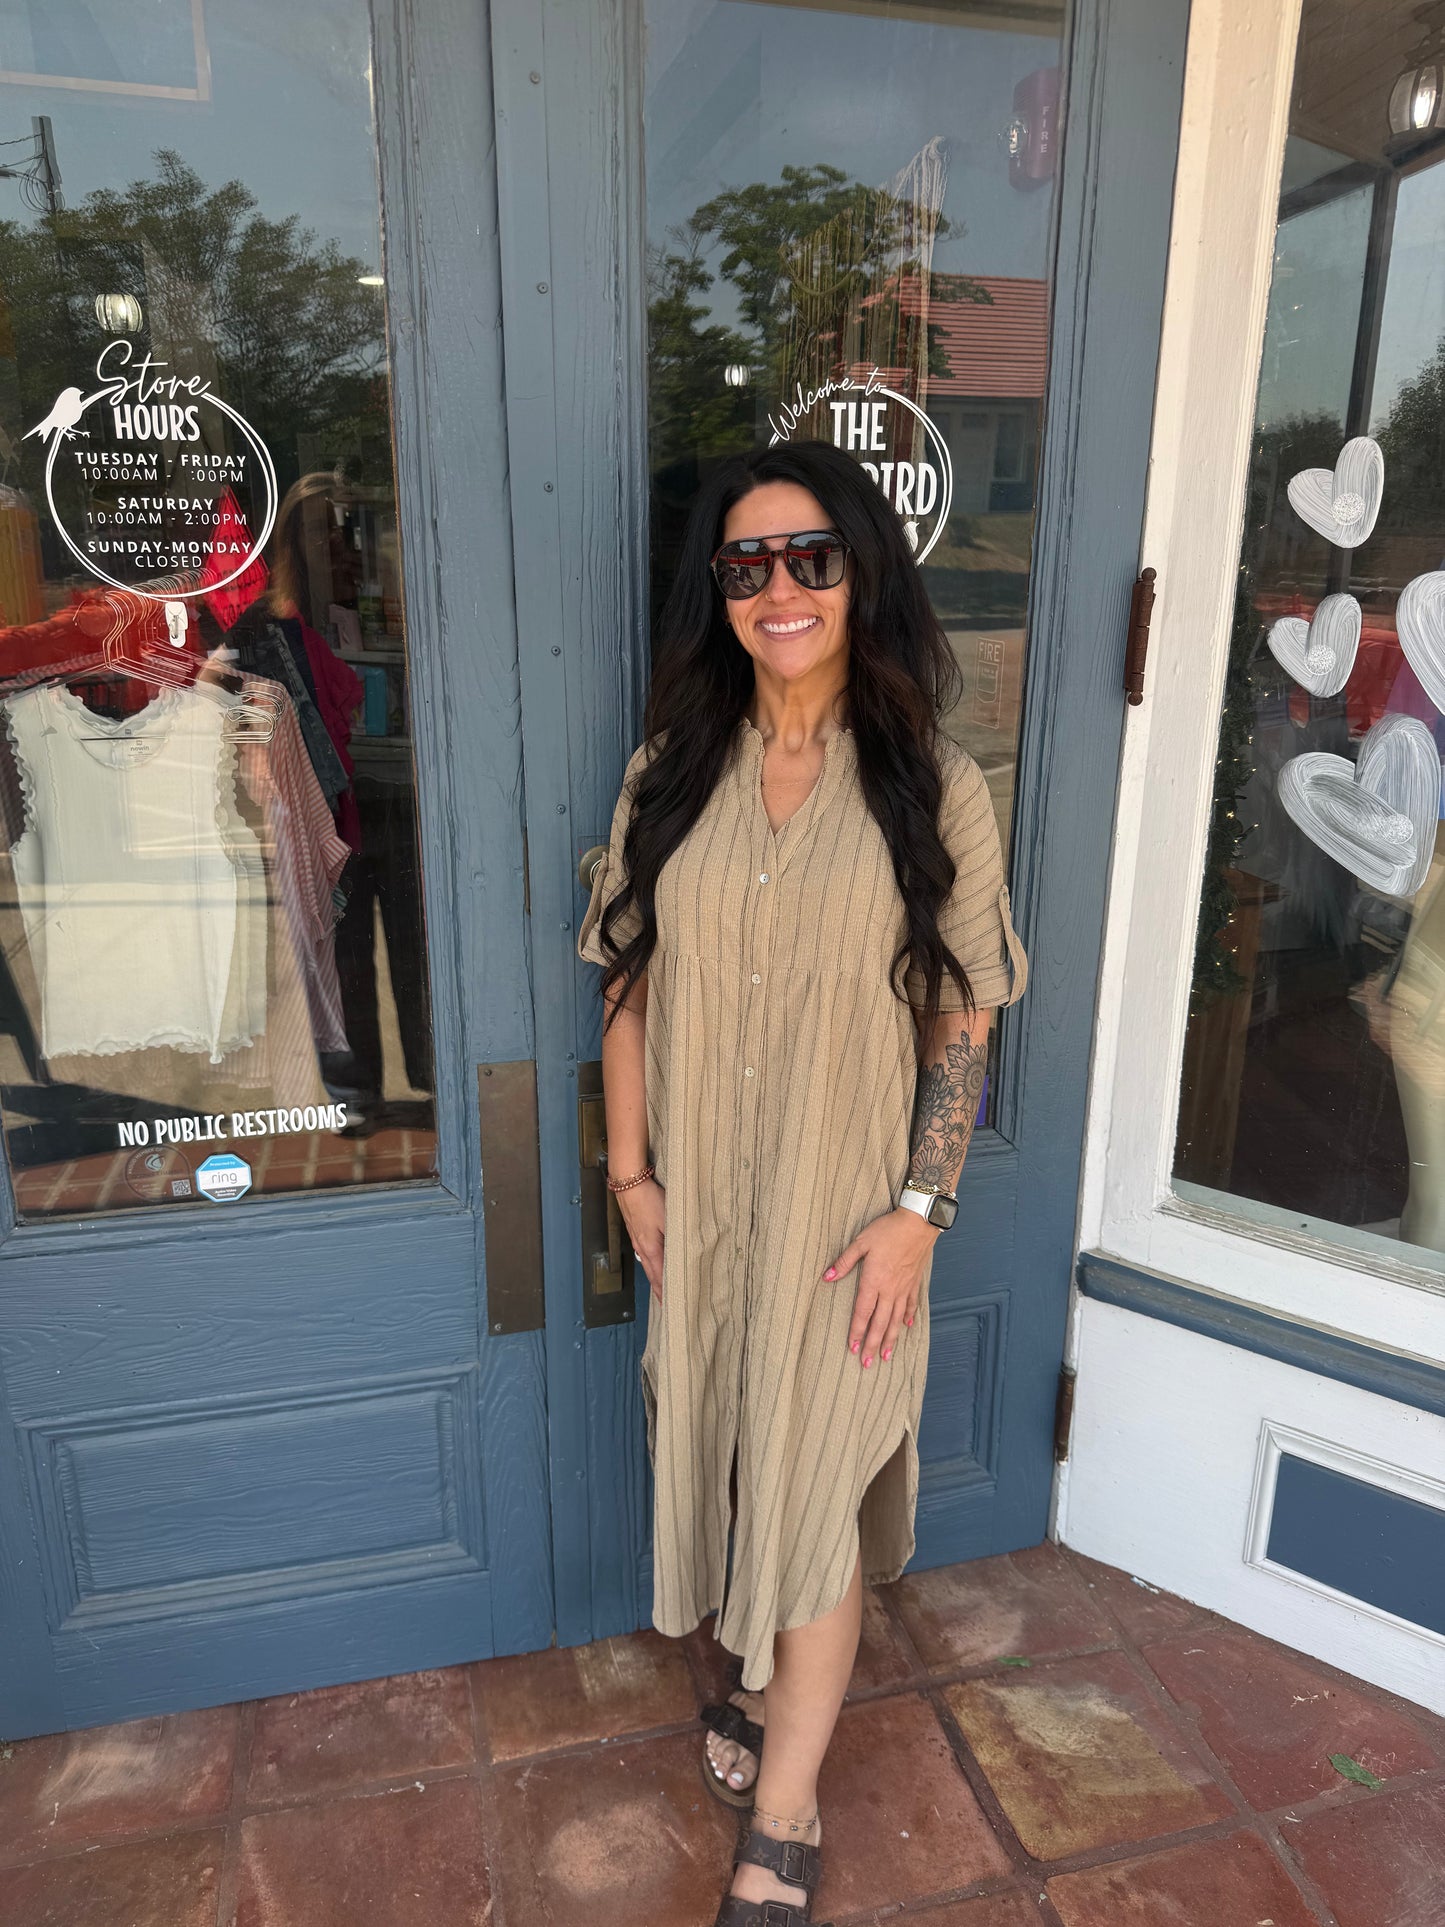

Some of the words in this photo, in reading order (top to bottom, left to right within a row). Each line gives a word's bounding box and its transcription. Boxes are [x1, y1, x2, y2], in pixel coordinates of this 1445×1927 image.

[1040, 105, 1050, 153] FIRE
[97, 340, 211, 405] Store
[768, 376, 855, 441] Welcome
[863, 366, 887, 396] to
[113, 404, 201, 442] HOURS
[829, 402, 887, 450] THE
[74, 452, 159, 466] TUESDAY
[180, 454, 247, 468] FRIDAY
[81, 467, 158, 481] 10:00AM
[117, 497, 214, 511] SATURDAY
[86, 511, 162, 525] 10:00AM
[184, 512, 247, 526] 2:00PM
[87, 540, 251, 554] SUNDAY-MONDAY
[134, 555, 202, 568] CLOSED
[979, 641, 1001, 662] FIRE
[118, 1120, 150, 1147] NO
[155, 1113, 228, 1145] PUBLIC
[231, 1103, 348, 1138] RESTROOMS
[211, 1172, 238, 1184] ring
